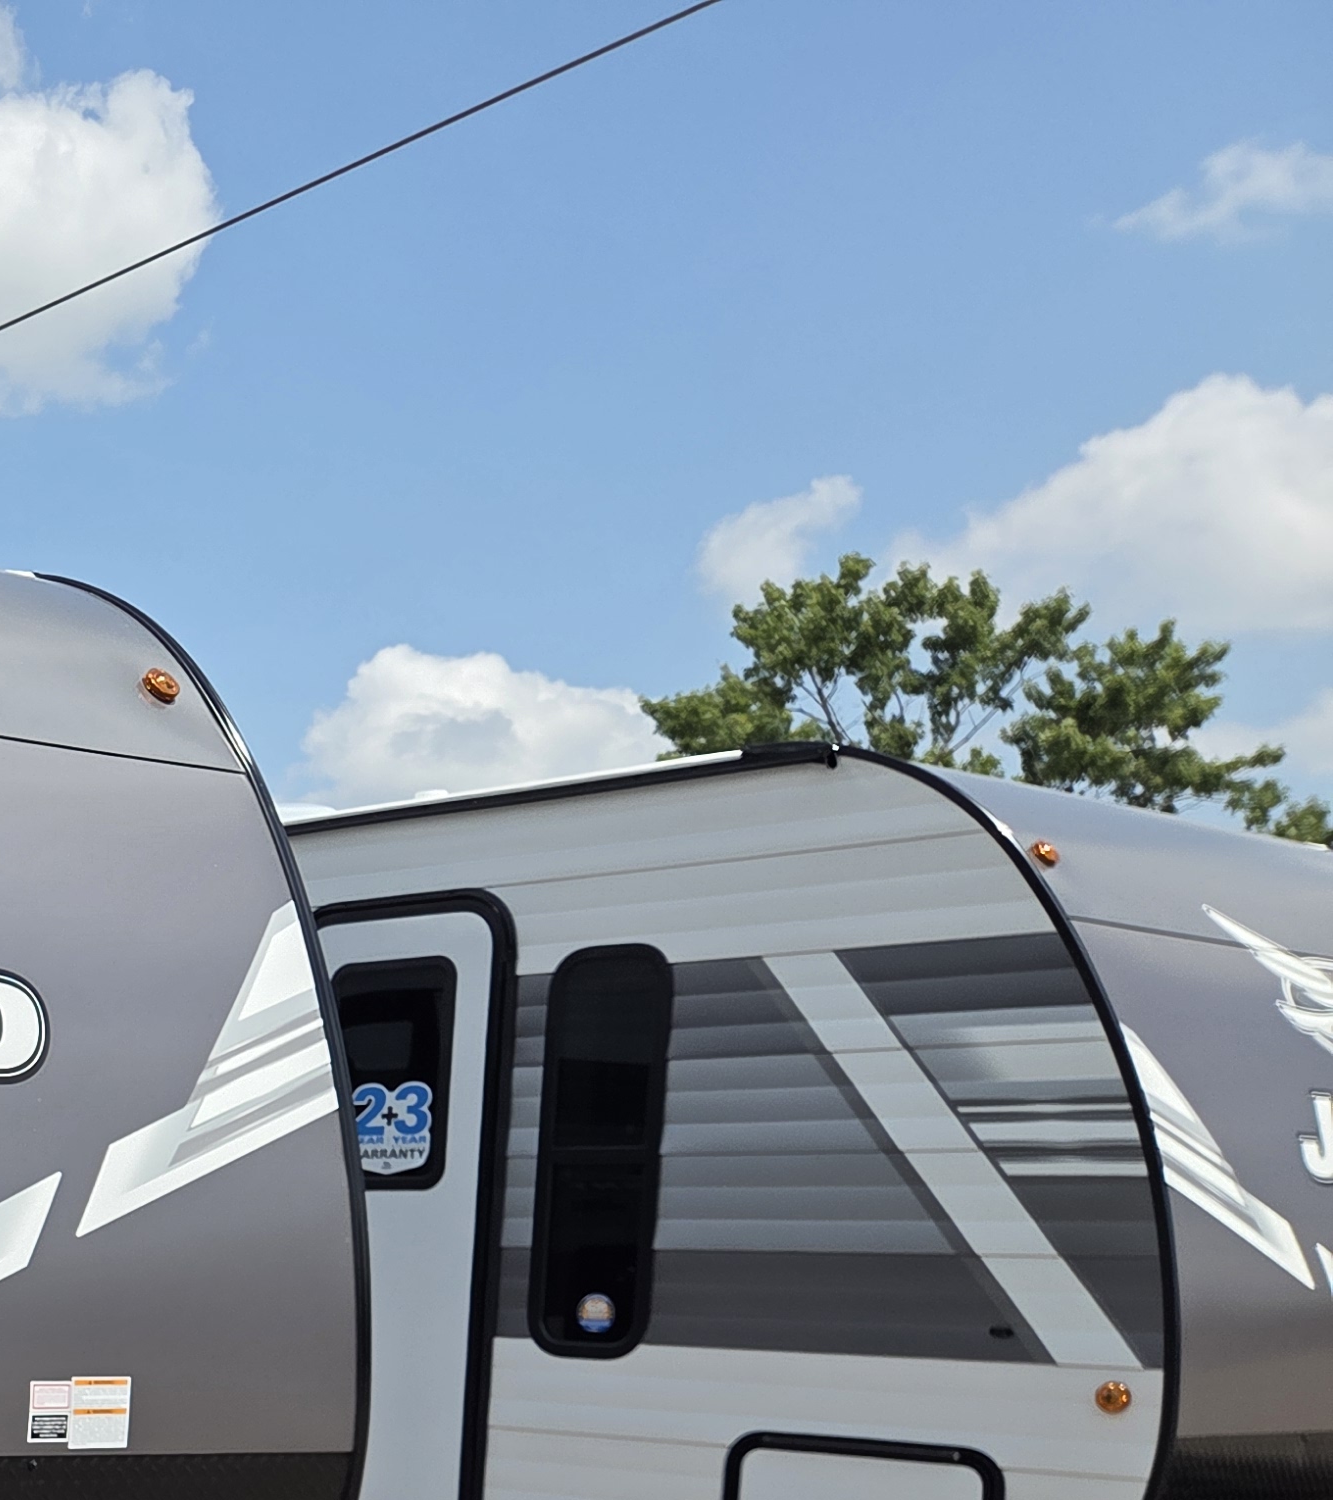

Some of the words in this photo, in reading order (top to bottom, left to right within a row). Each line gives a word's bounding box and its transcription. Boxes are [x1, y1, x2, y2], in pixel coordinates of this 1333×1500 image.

[359, 1136, 384, 1145] EAR
[393, 1135, 427, 1145] YEAR
[361, 1147, 426, 1160] ARRANTY
